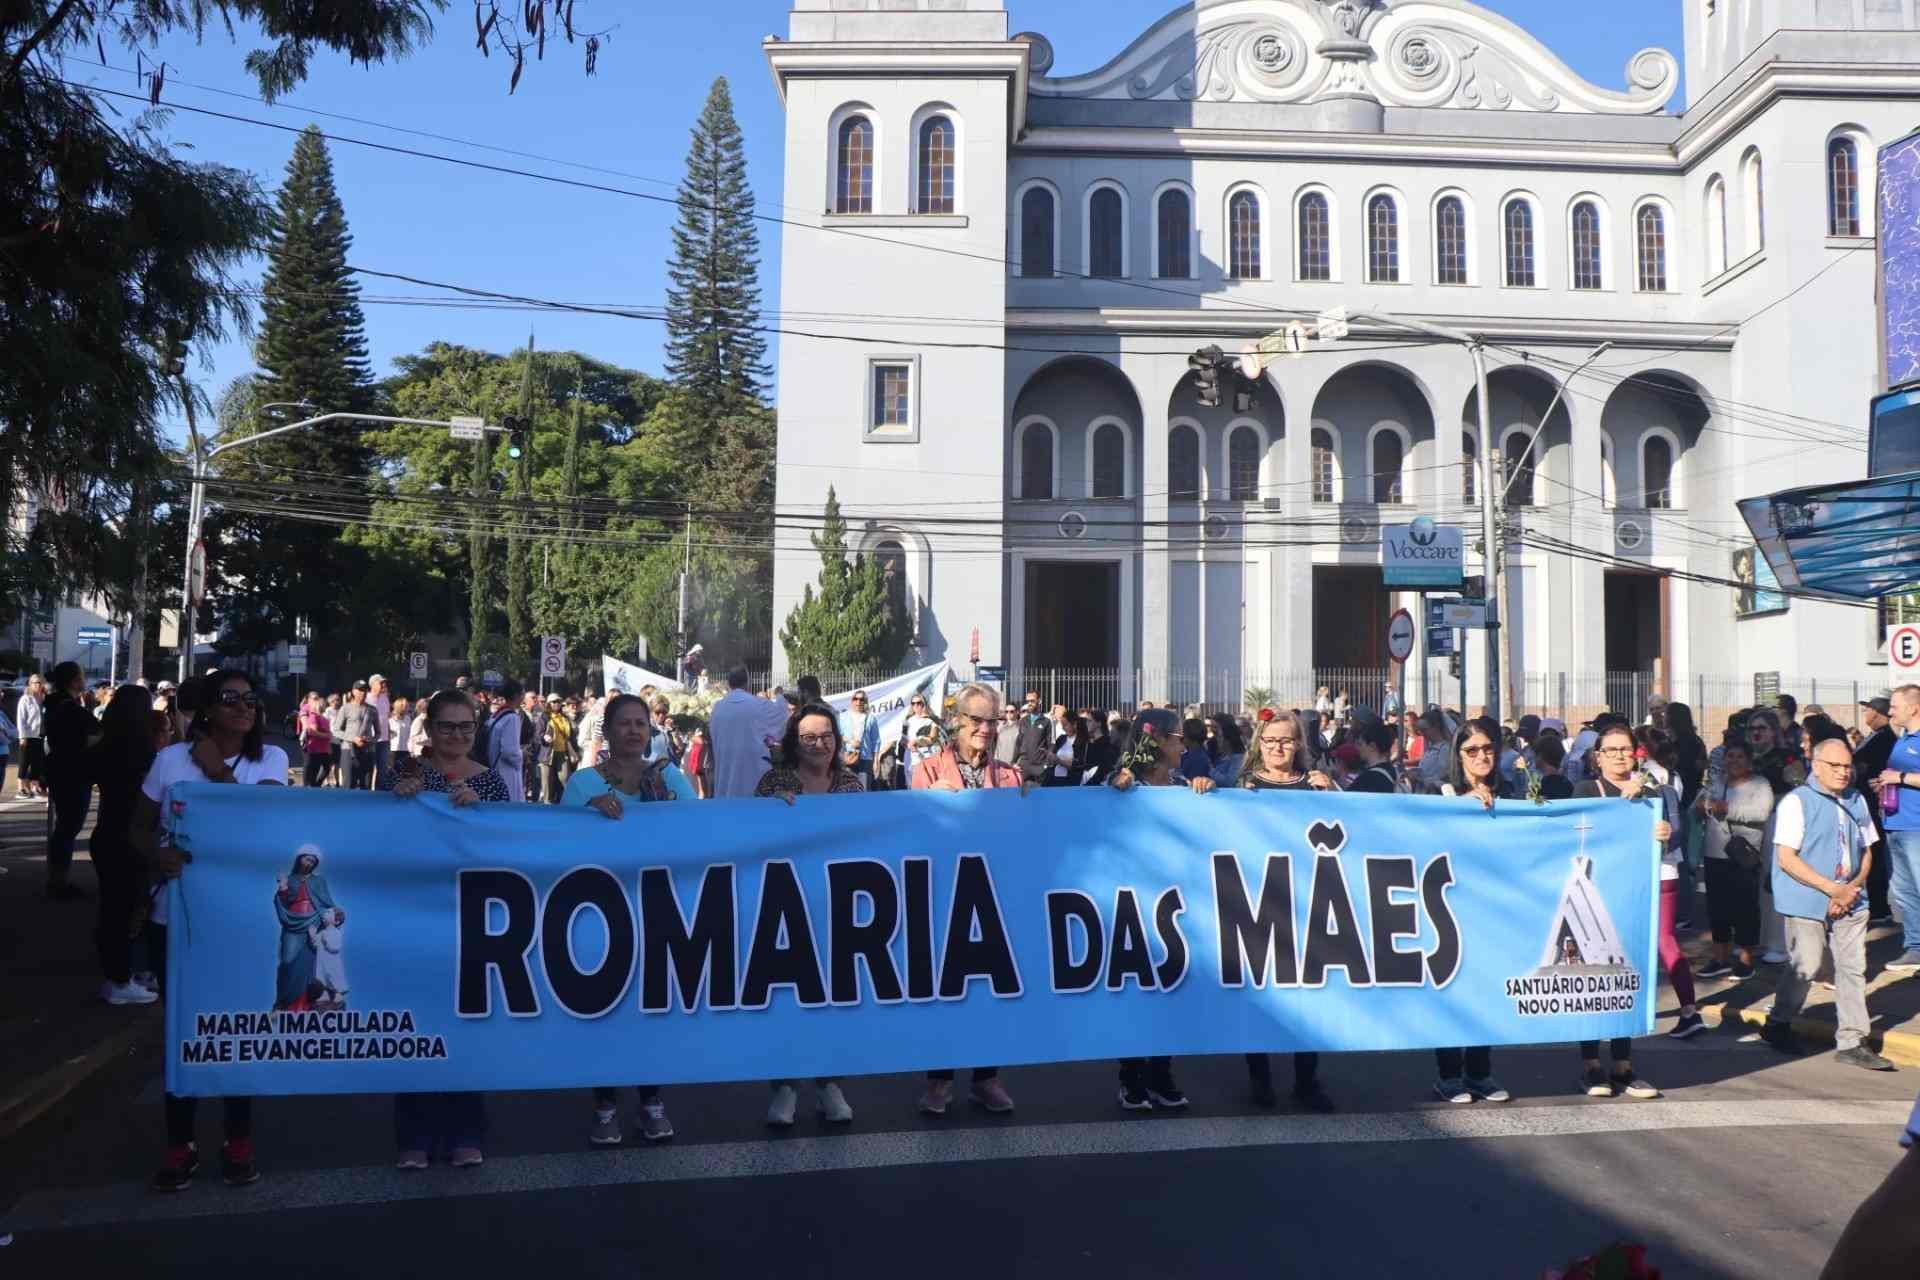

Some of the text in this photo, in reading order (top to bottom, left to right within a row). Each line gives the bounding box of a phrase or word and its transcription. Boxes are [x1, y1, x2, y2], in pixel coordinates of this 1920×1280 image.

[1902, 636, 1912, 659] E
[416, 656, 424, 666] E
[869, 697, 905, 713] ARIA
[456, 818, 1463, 1019] ROMARIA DAS MÃES
[1506, 971, 1641, 996] SANTUÁRIO DAS MÃES
[1518, 995, 1634, 1015] NOVO HAMBURGO
[197, 1011, 415, 1036] MARIA IMACULADA
[182, 1036, 448, 1063] MÃE EVANGELIZADORA
